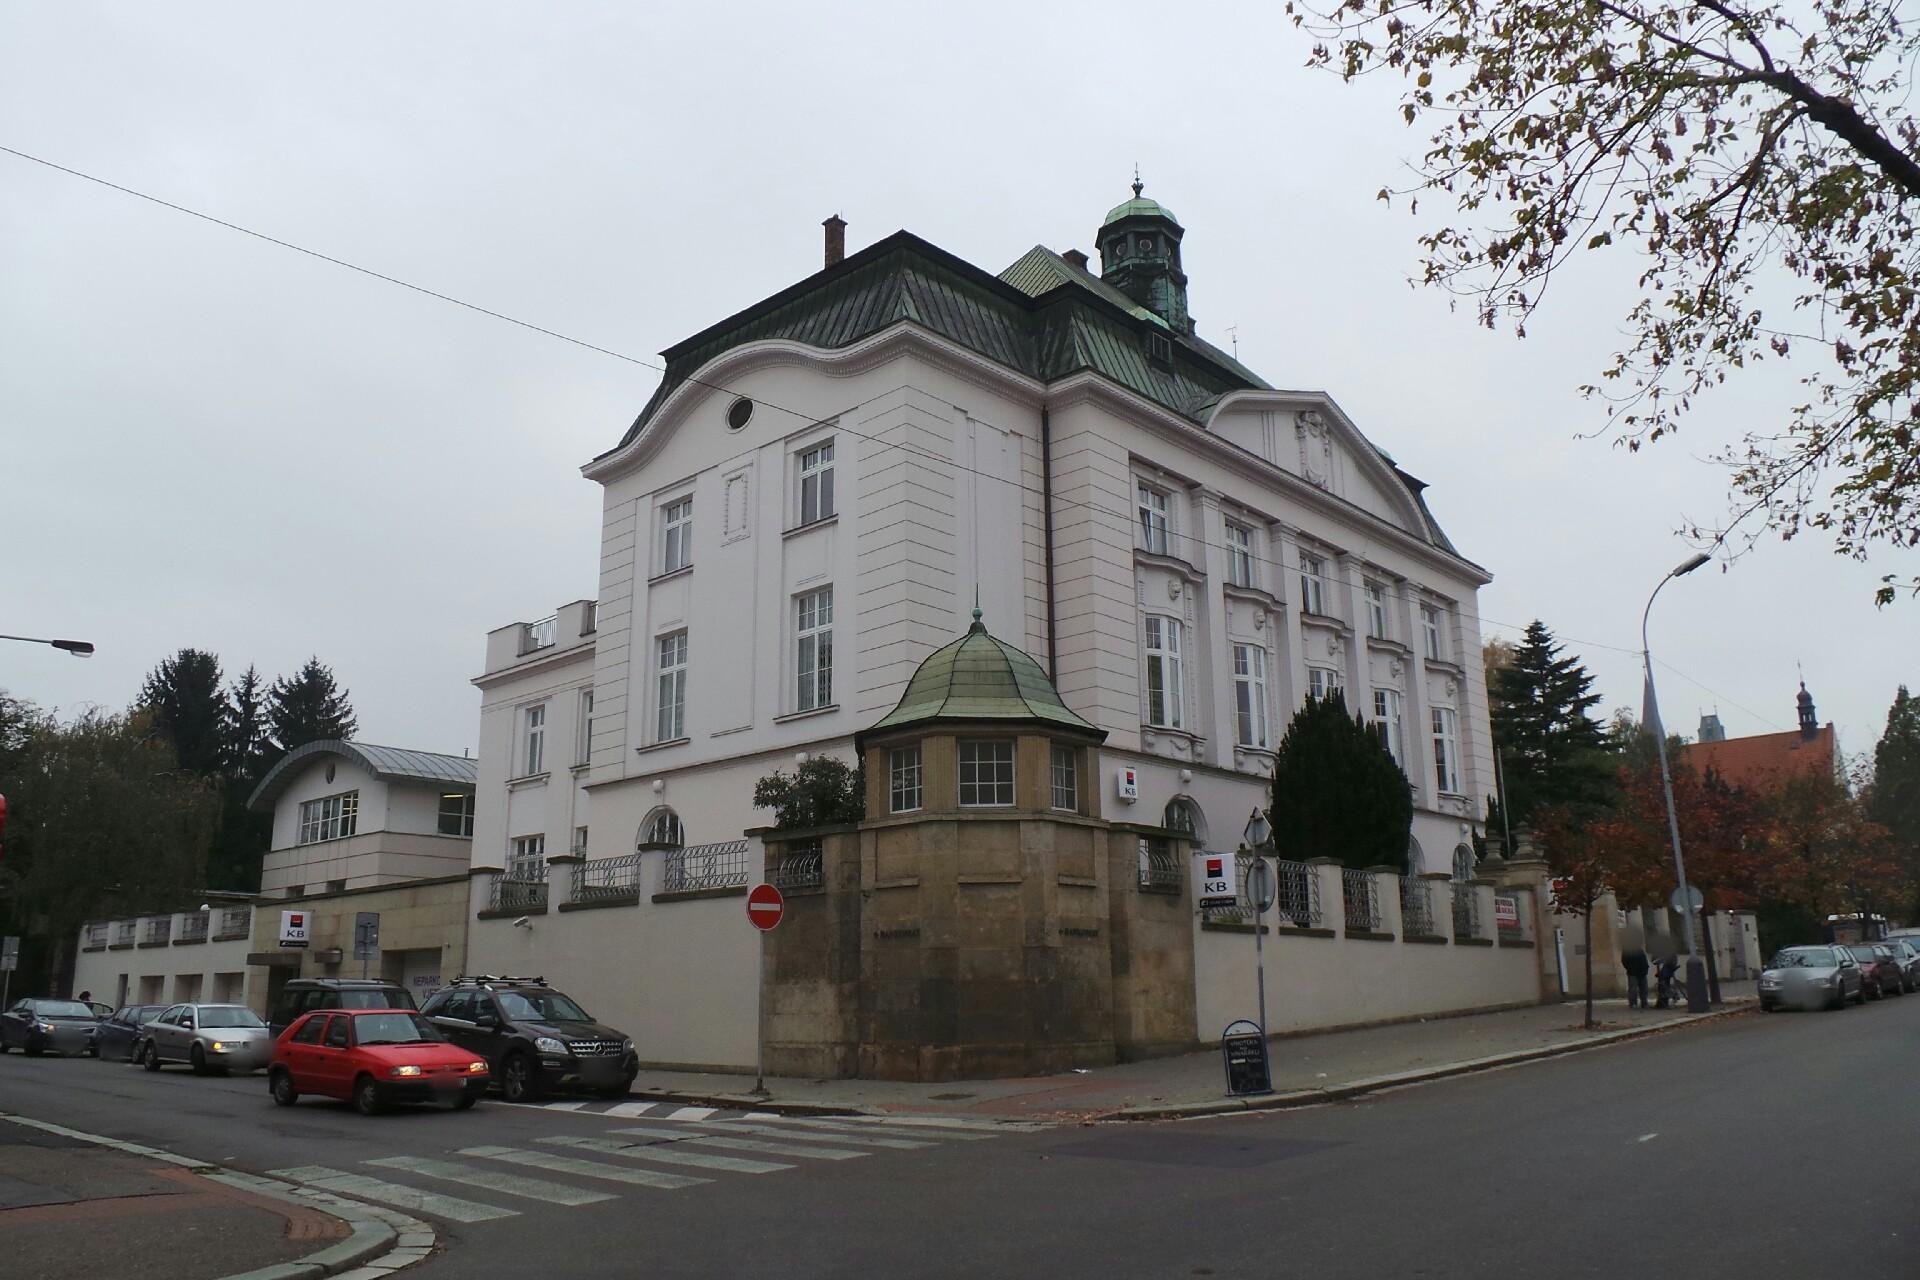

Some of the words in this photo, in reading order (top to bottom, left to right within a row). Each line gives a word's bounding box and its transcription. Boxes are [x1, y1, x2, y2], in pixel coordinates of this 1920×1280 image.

[1125, 787, 1136, 796] KB
[1204, 881, 1227, 893] KB
[287, 929, 305, 938] KB
